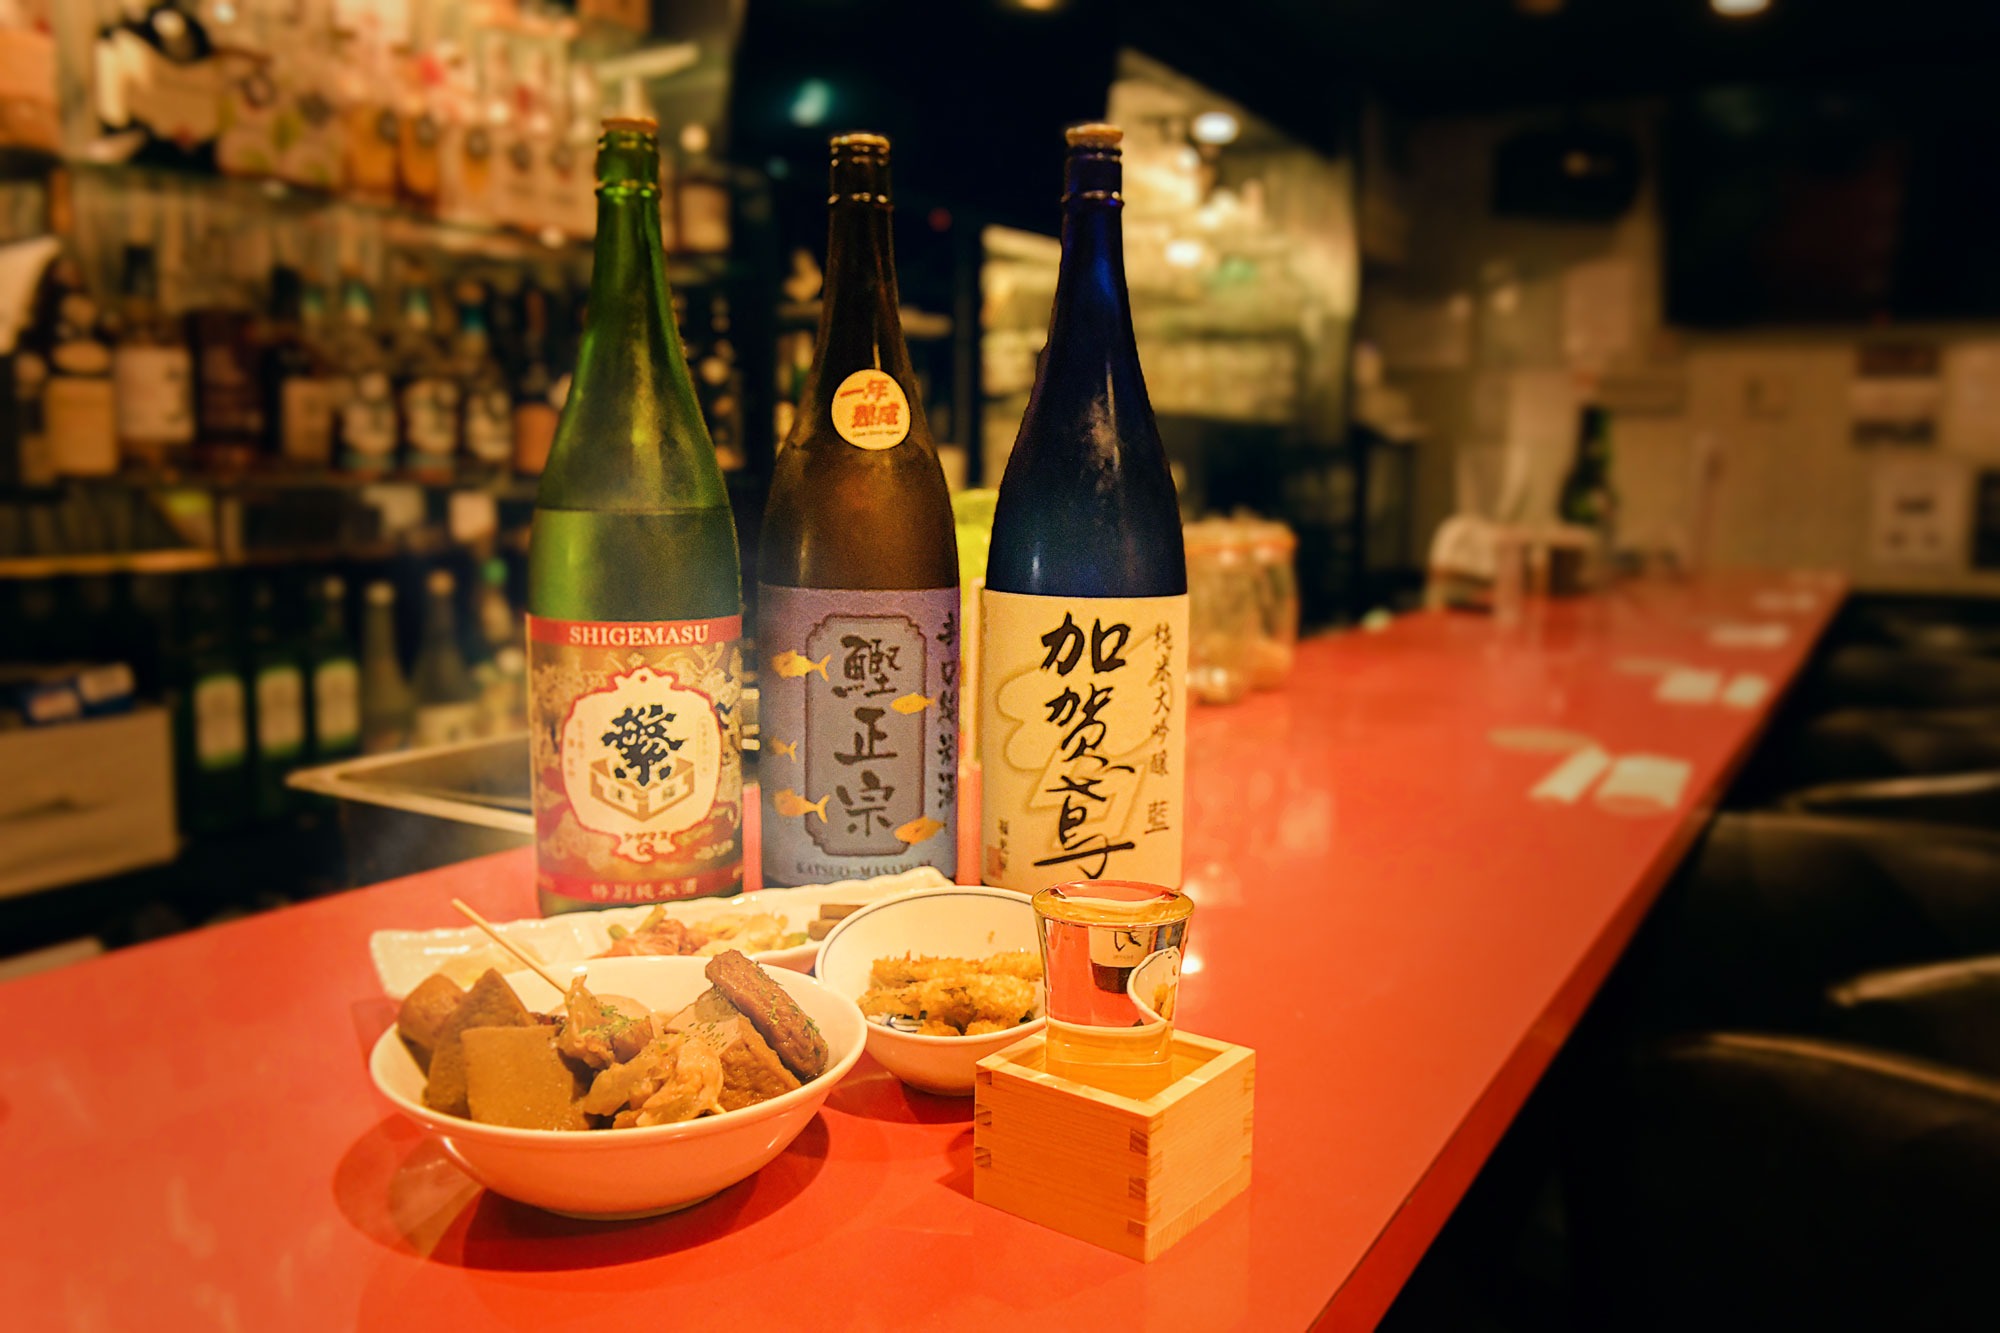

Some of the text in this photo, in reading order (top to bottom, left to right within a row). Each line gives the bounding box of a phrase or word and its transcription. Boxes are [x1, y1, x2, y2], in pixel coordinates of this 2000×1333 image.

[840, 379, 889, 402] 一年
[852, 402, 900, 428] 熟成
[569, 624, 709, 646] SHIGEMASU
[831, 634, 901, 837] 鰹正宗
[591, 877, 698, 900] 特別純米酒
